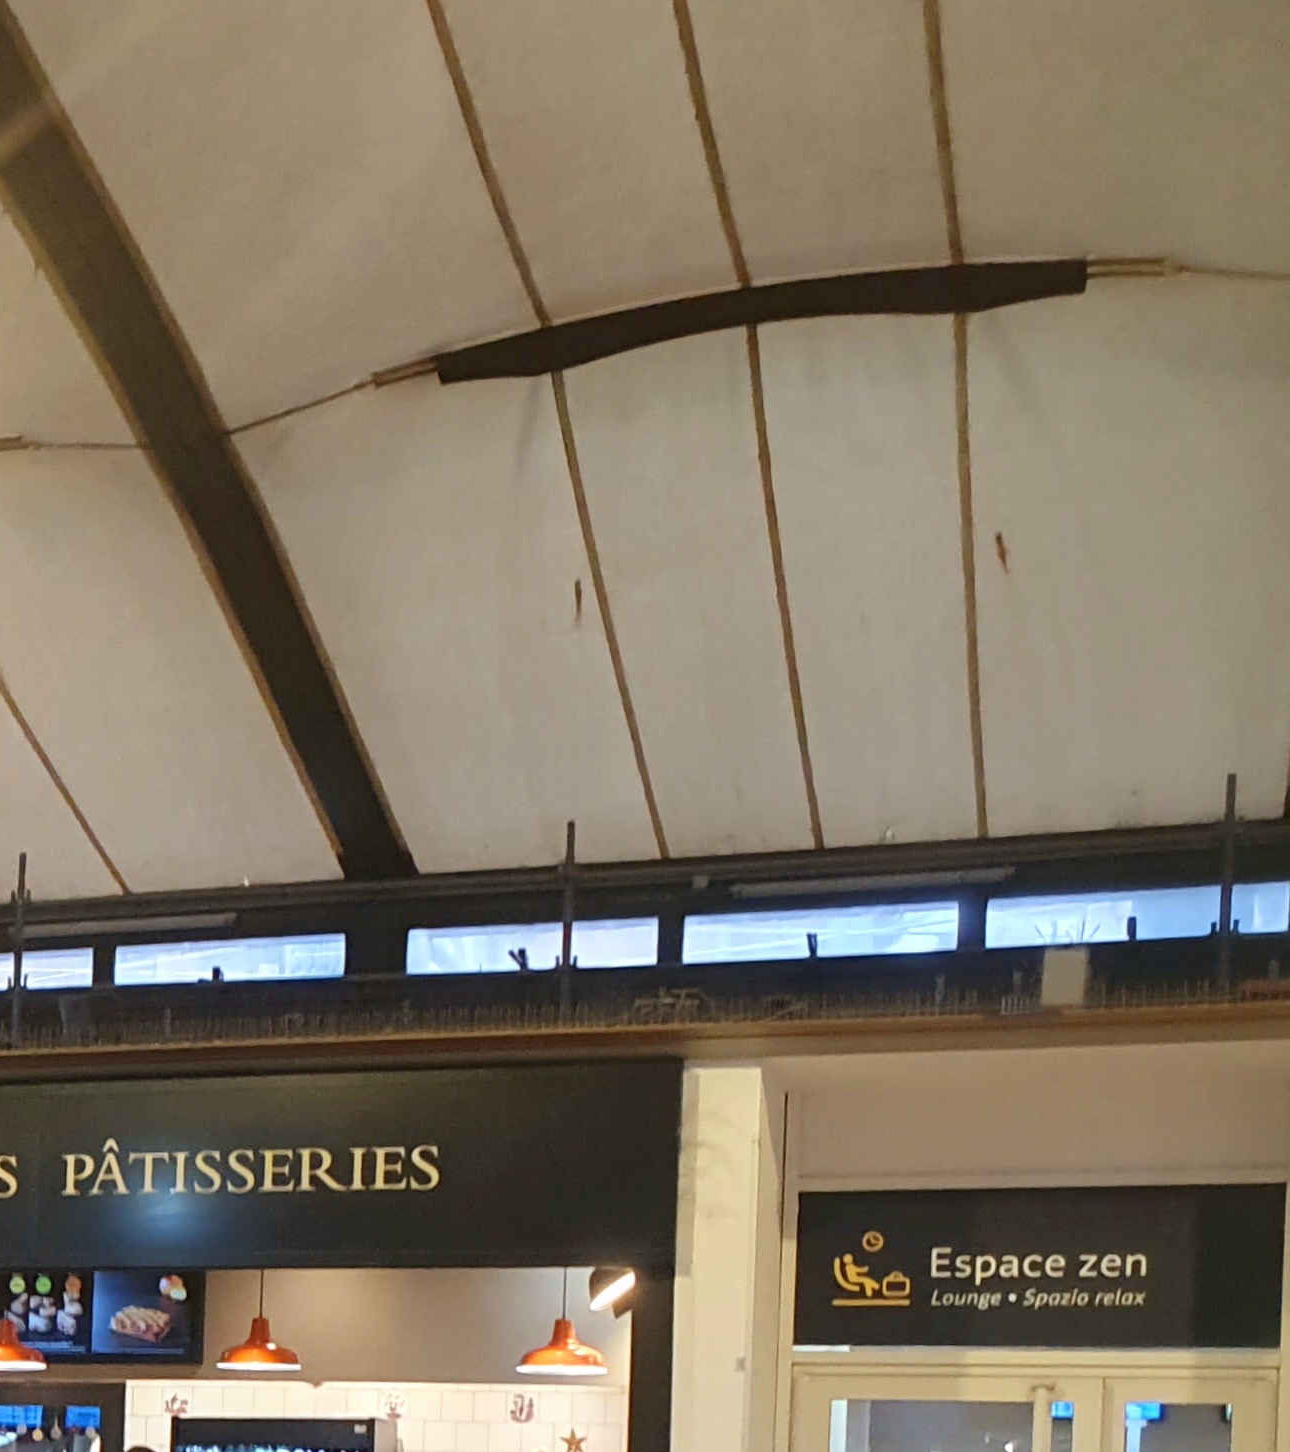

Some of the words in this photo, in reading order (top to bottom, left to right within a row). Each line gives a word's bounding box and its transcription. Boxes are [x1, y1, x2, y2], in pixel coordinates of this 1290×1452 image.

[61, 1138, 442, 1198] PÂTISSERIES
[931, 1246, 1066, 1285] Espace
[1078, 1251, 1147, 1279] zen
[931, 1290, 1001, 1311] Lounge
[1023, 1289, 1089, 1311] Spazio
[1095, 1290, 1146, 1308] relax
